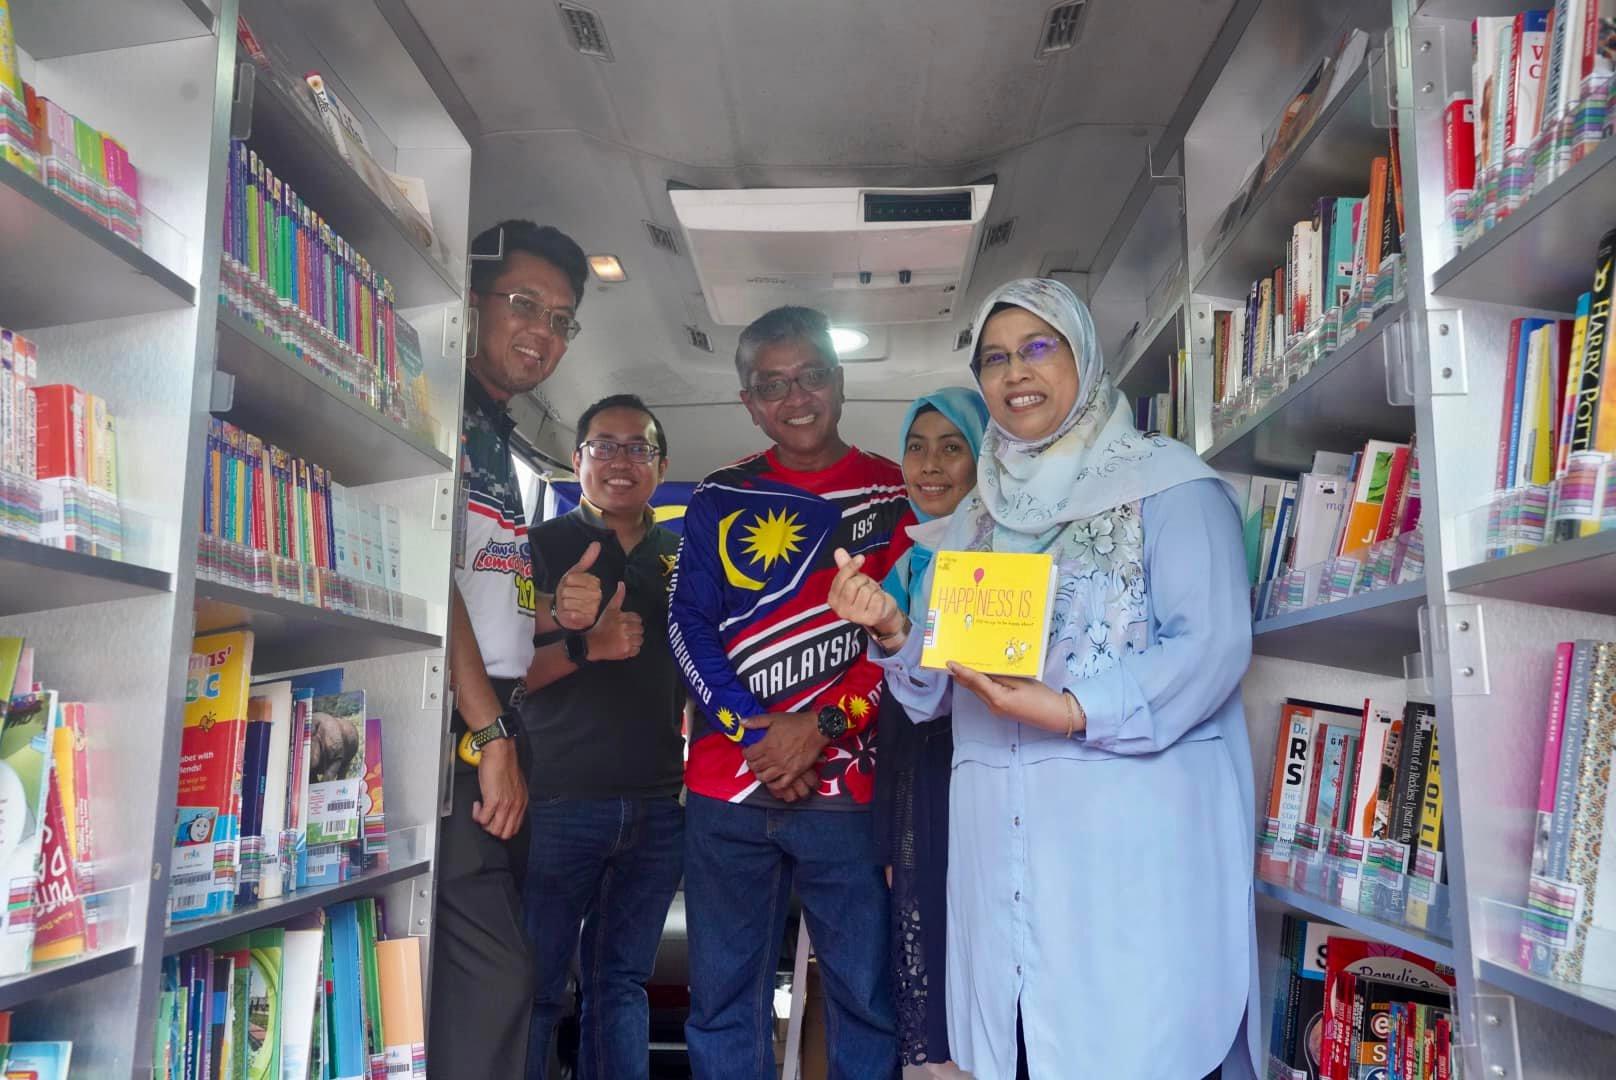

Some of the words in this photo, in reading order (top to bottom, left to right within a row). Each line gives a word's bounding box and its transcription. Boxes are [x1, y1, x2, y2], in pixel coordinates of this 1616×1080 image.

[1583, 298, 1610, 379] HARRY
[1573, 386, 1600, 451] POTT
[938, 586, 1014, 618] HAPPINESS
[1018, 589, 1032, 618] IS
[1577, 647, 1588, 673] The
[1568, 679, 1584, 724] Middle
[1564, 729, 1579, 775] Eastern
[1407, 773, 1419, 801] Reckless
[1425, 782, 1439, 818] OF
[1403, 803, 1416, 825] Upstart
[1556, 780, 1571, 833] Kitchen
[1403, 828, 1411, 842] into
